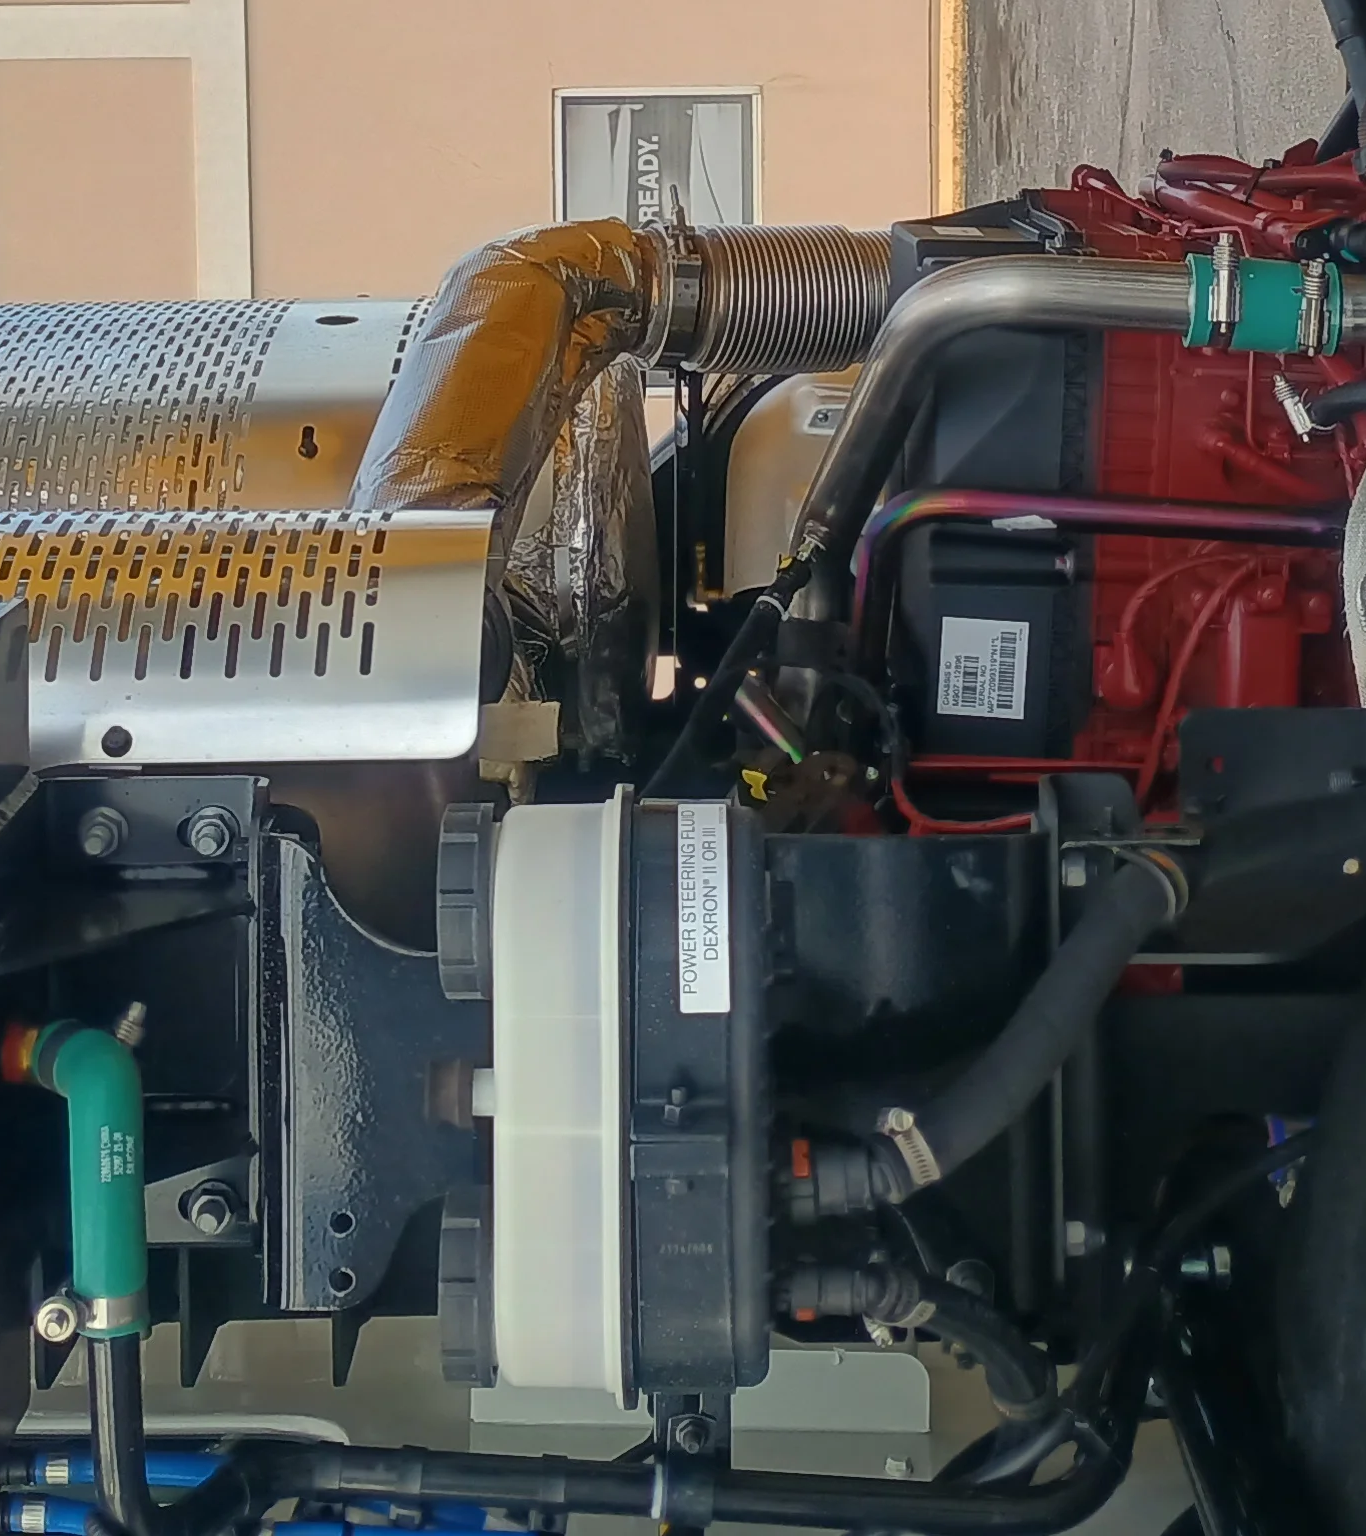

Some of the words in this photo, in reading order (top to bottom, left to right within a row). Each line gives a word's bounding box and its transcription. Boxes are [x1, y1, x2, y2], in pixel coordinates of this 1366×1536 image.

[944, 661, 952, 670] ID
[980, 665, 987, 677] NO
[942, 671, 952, 706] CHASSIS
[978, 679, 986, 707] SERIAL
[680, 810, 695, 840] FLUID
[702, 827, 716, 837] III
[702, 841, 717, 861] OR
[681, 843, 697, 923] STEERING
[702, 866, 717, 874] II
[682, 929, 698, 994] POWER
[637, 1135, 660, 1220] READY.
